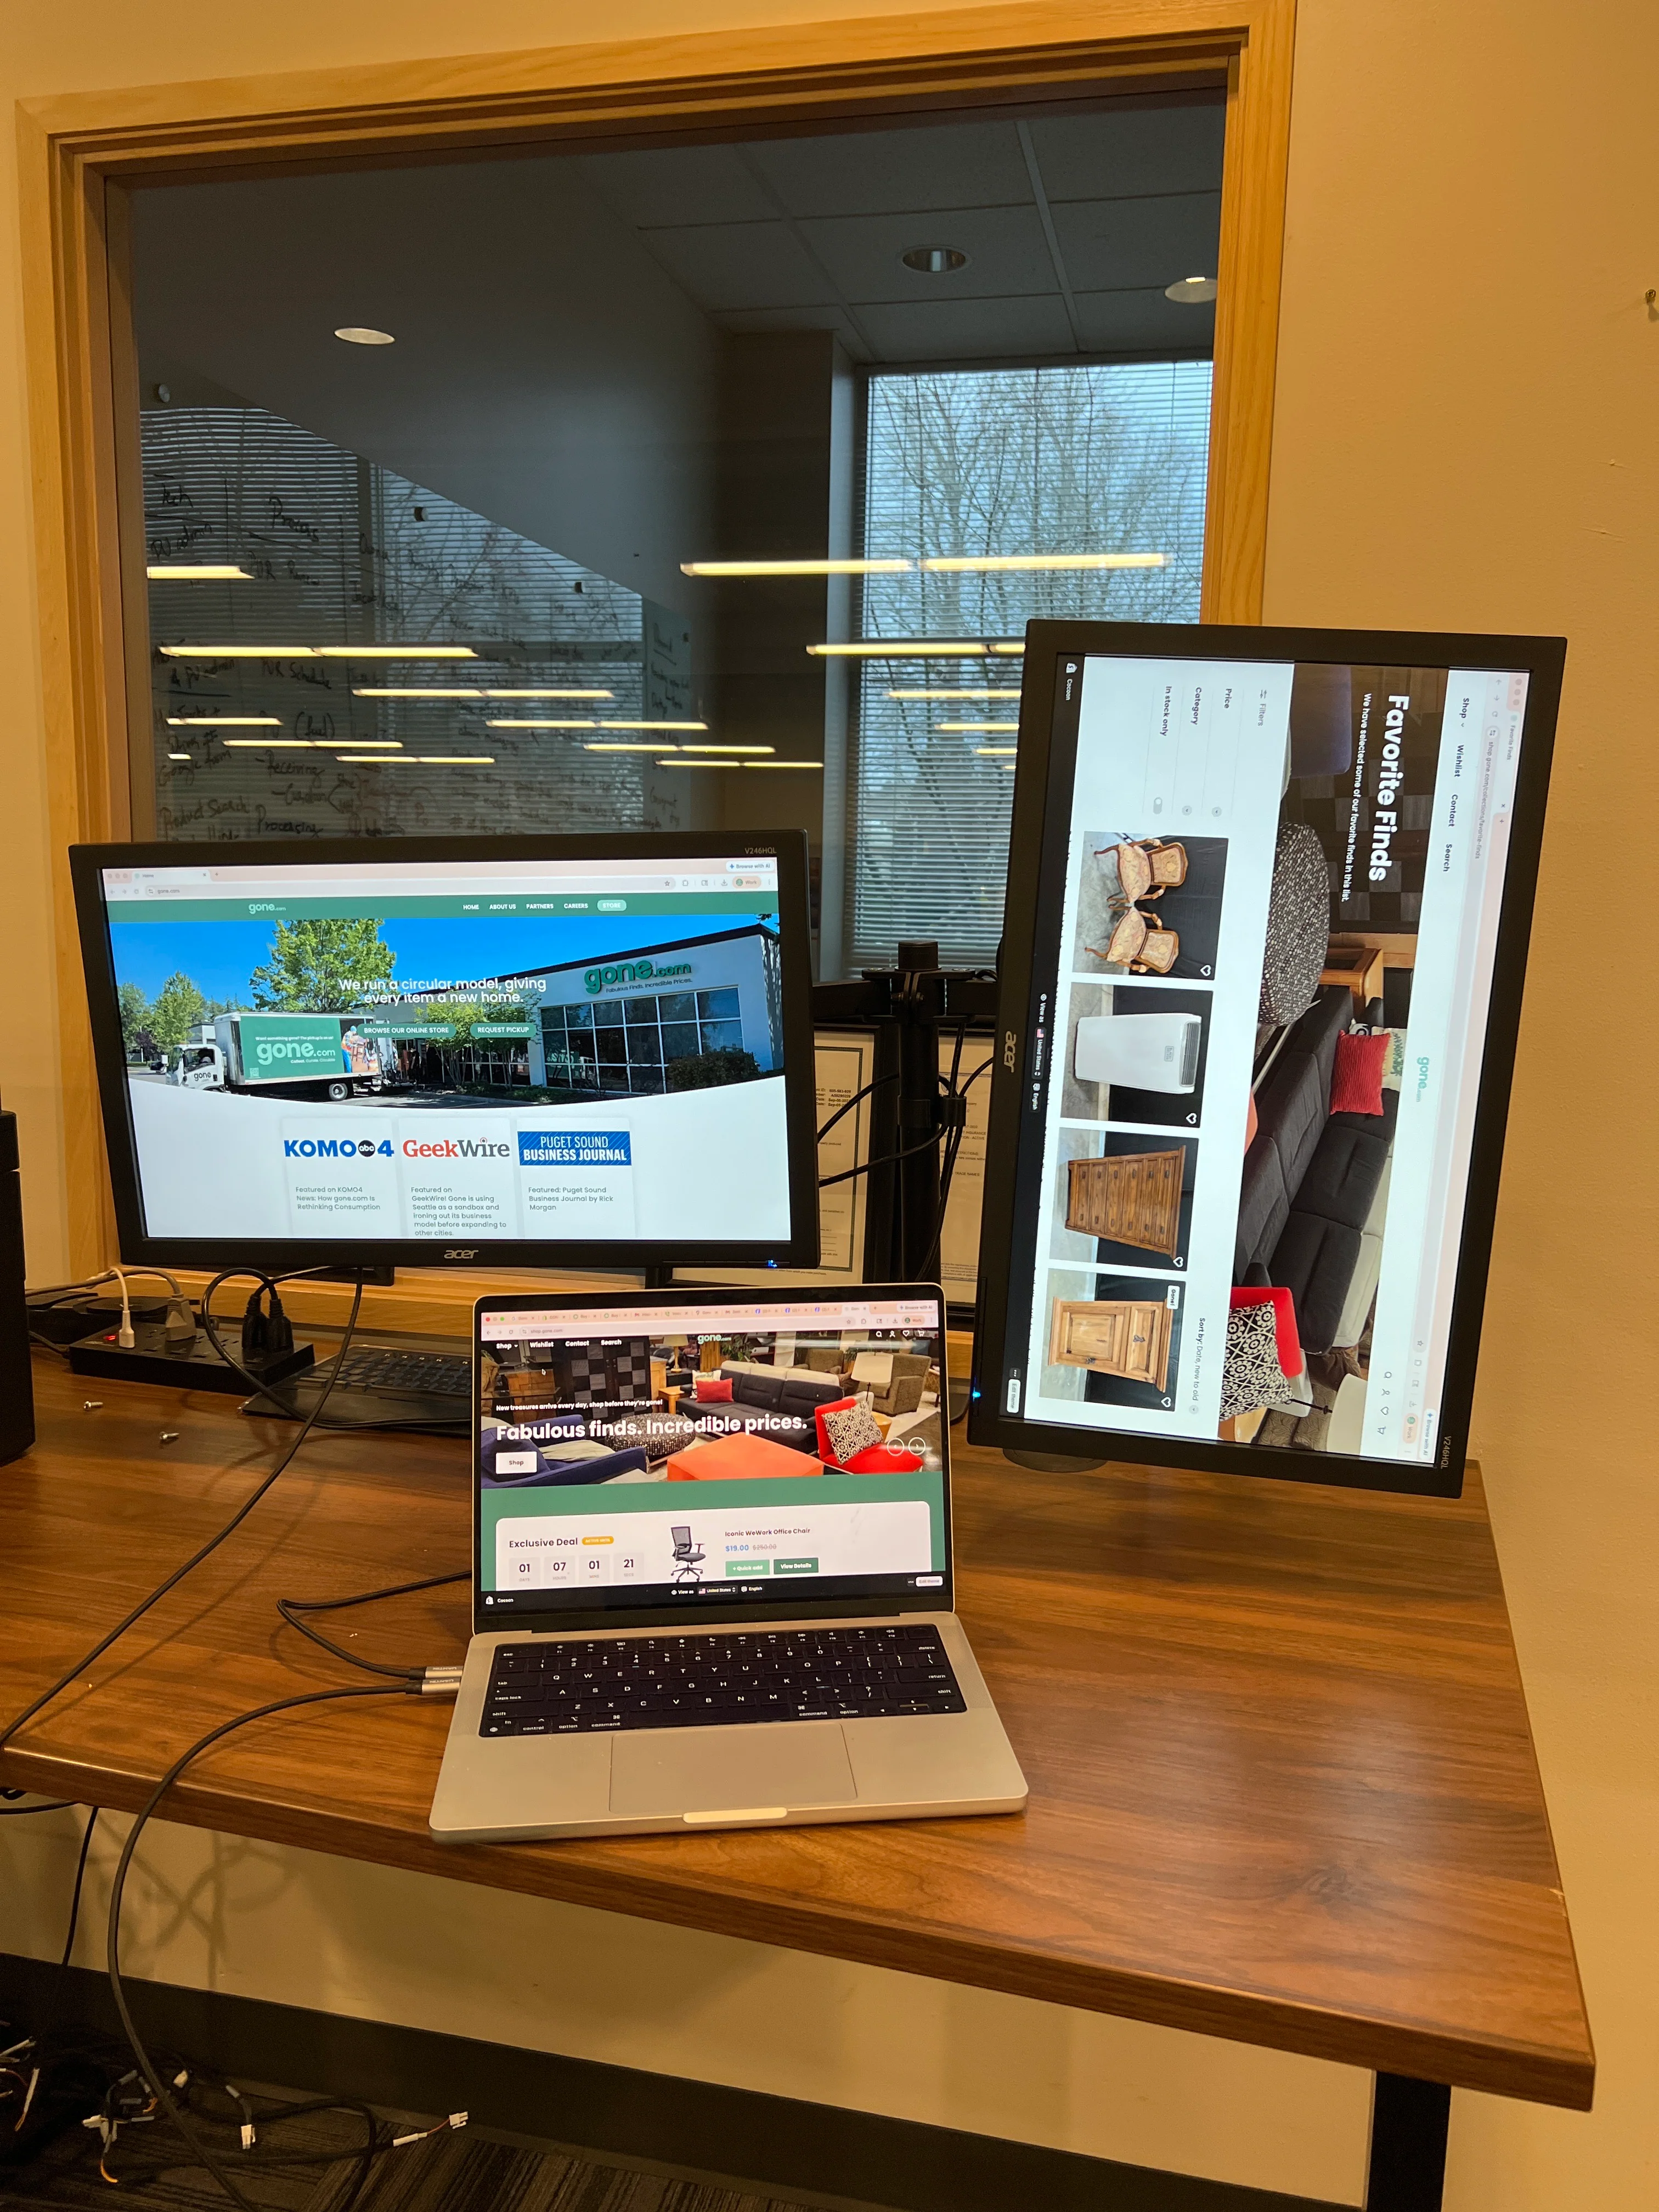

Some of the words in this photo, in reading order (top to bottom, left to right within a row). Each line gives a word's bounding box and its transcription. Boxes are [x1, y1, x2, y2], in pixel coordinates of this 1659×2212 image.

[1161, 695, 1171, 718] stock
[1190, 687, 1201, 725] Category
[1223, 689, 1232, 709] Price
[1362, 693, 1372, 707] We
[1459, 698, 1469, 718] Shop
[1256, 703, 1266, 726] Filters
[1360, 708, 1369, 728] have
[1159, 719, 1169, 736] only
[1508, 725, 1516, 746] Favorite
[1356, 730, 1367, 764] selected
[1376, 695, 1410, 806] Favorite
[1453, 745, 1464, 777] Wishlist
[1353, 765, 1362, 787] some
[1352, 789, 1361, 797] of
[1351, 799, 1359, 812] our
[1448, 794, 1458, 827] Contact
[1347, 814, 1359, 843] favorite
[1345, 844, 1356, 864] finds
[1368, 811, 1397, 881] Finds
[1442, 844, 1452, 872] Search
[1342, 874, 1352, 888] this
[1340, 889, 1351, 902] list.
[249, 902, 286, 915] gone.com
[339, 979, 360, 990] We
[364, 981, 385, 990] run
[390, 981, 398, 990] a
[402, 978, 453, 990] circular
[456, 978, 502, 992] model,
[505, 977, 546, 992] giving
[584, 960, 691, 994] gone.com
[364, 994, 400, 1007] every
[404, 992, 434, 1003] item
[437, 994, 447, 1003] a
[450, 994, 477, 1003] new
[481, 991, 524, 1003] home.
[257, 1043, 335, 1065] gone.com
[1003, 1031, 1017, 1073] acer
[194, 1072, 212, 1081] gone
[1415, 1057, 1430, 1102] gone.com
[284, 1139, 357, 1157] KOMO
[377, 1139, 394, 1157] 4
[403, 1138, 510, 1158] GeekWire
[540, 1136, 572, 1148] PUGET
[575, 1136, 608, 1148] SOUND
[523, 1149, 576, 1161] BUSINESS
[578, 1149, 627, 1161] JOURNAL
[444, 1249, 478, 1259] acer
[1195, 1334, 1204, 1345] by:
[1194, 1346, 1203, 1363] Date,
[646, 1399, 663, 1407] gone!
[496, 1423, 586, 1441] Fabulous
[590, 1420, 642, 1437] finds.
[647, 1414, 741, 1434] Incredible
[745, 1413, 808, 1435] prices.
[1440, 1436, 1452, 1469] V246HQL
[509, 1538, 554, 1548] Exclusive
[556, 1538, 578, 1547] Deal
[725, 1544, 749, 1552] $19.00
[519, 1564, 530, 1573] 01
[553, 1562, 566, 1571] 07
[589, 1560, 600, 1570] 01
[624, 1559, 634, 1568] 21
